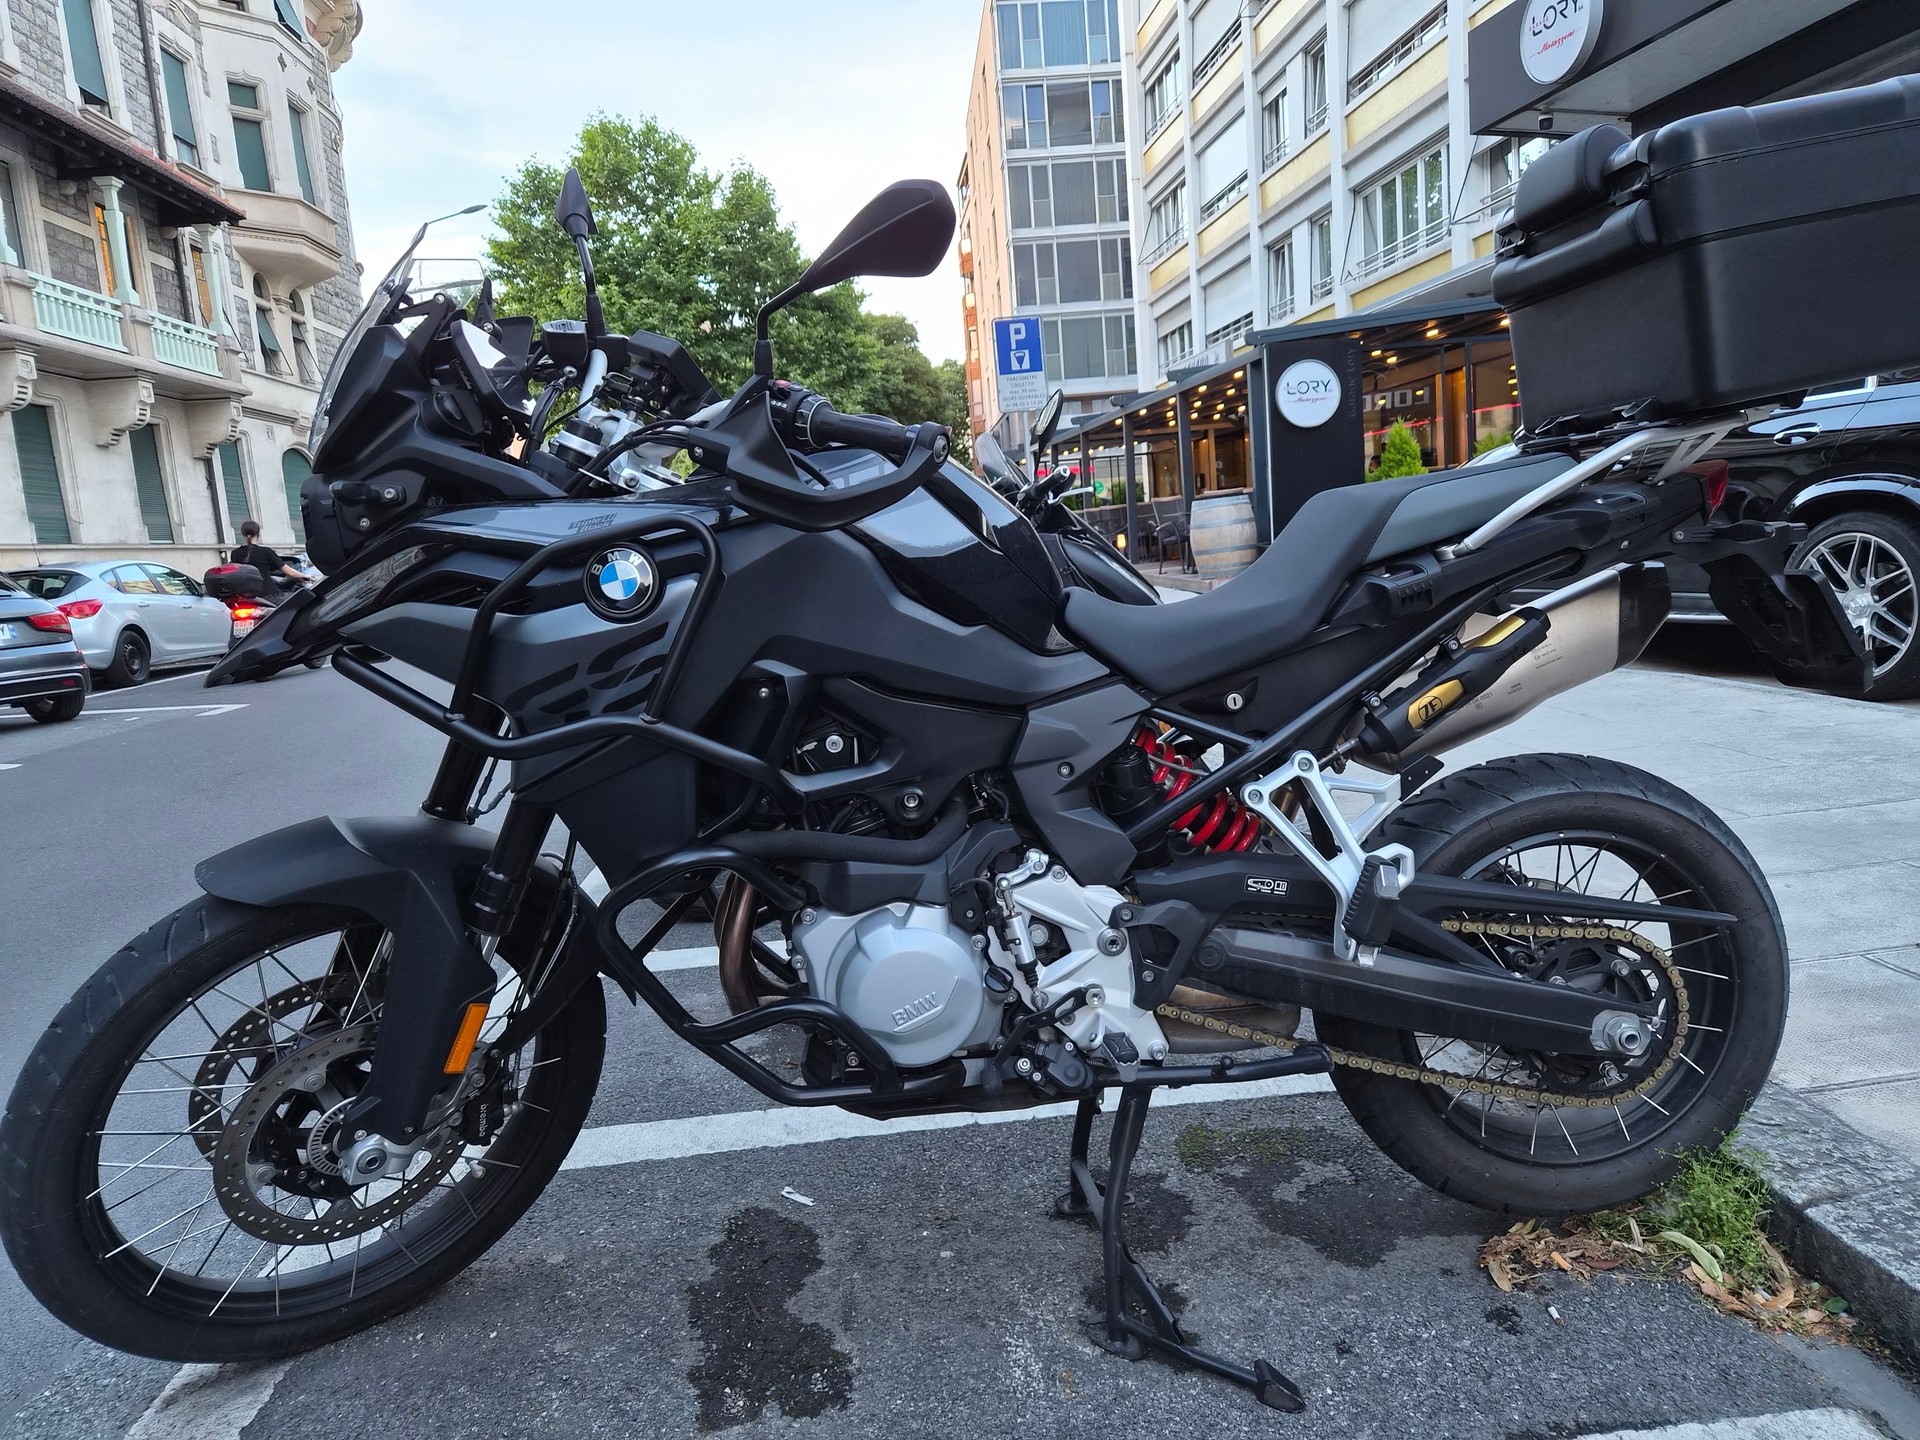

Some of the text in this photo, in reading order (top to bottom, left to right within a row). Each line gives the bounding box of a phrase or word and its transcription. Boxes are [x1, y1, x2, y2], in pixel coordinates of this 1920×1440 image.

[1529, 16, 1549, 32] GARAGE
[1532, 0, 1578, 37] LORY
[1009, 323, 1026, 350] P
[1286, 379, 1331, 395] LORY
[580, 522, 610, 532] Black
[591, 551, 642, 575] BMW
[1419, 697, 1438, 719] ZF
[892, 991, 937, 1027] BMW
[478, 1103, 489, 1137] brembo
